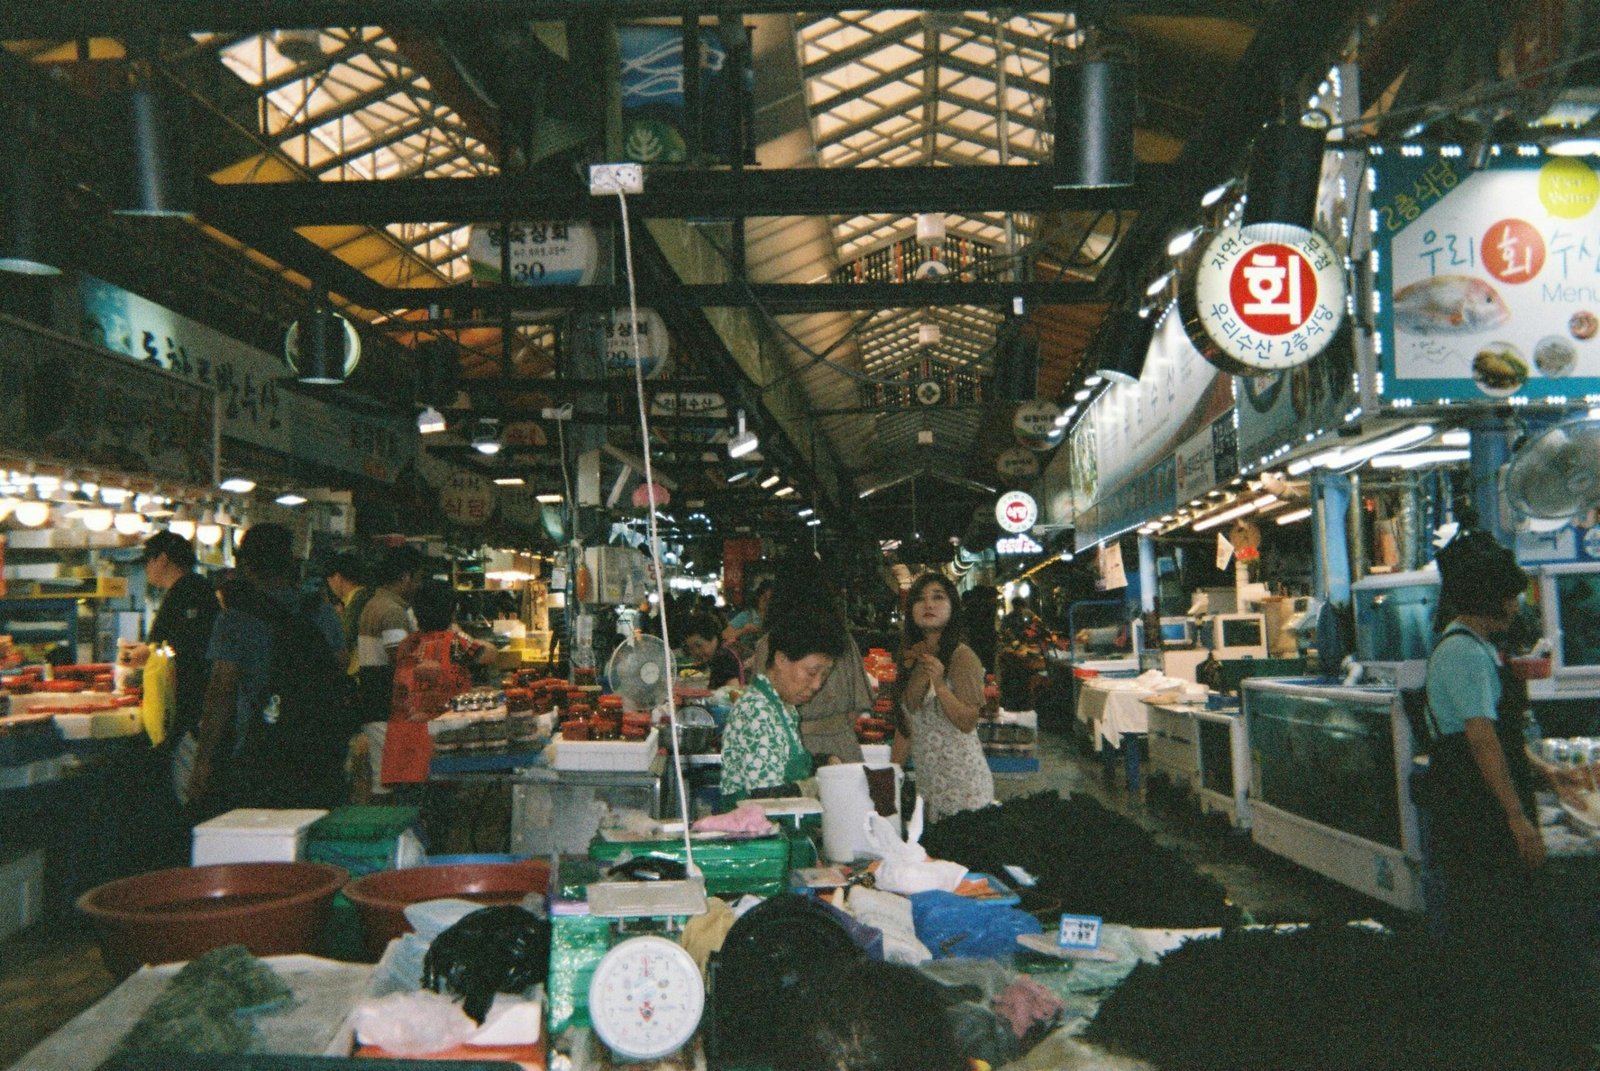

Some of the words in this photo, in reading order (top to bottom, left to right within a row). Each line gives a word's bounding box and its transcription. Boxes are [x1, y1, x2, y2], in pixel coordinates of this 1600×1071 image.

[1379, 158, 1459, 231] 2층식당
[1419, 228, 1475, 277] 우리
[1498, 224, 1533, 277] 회
[1242, 253, 1303, 326] 회
[1210, 302, 1274, 361] 우리수산
[1281, 303, 1334, 357] 2층식당
